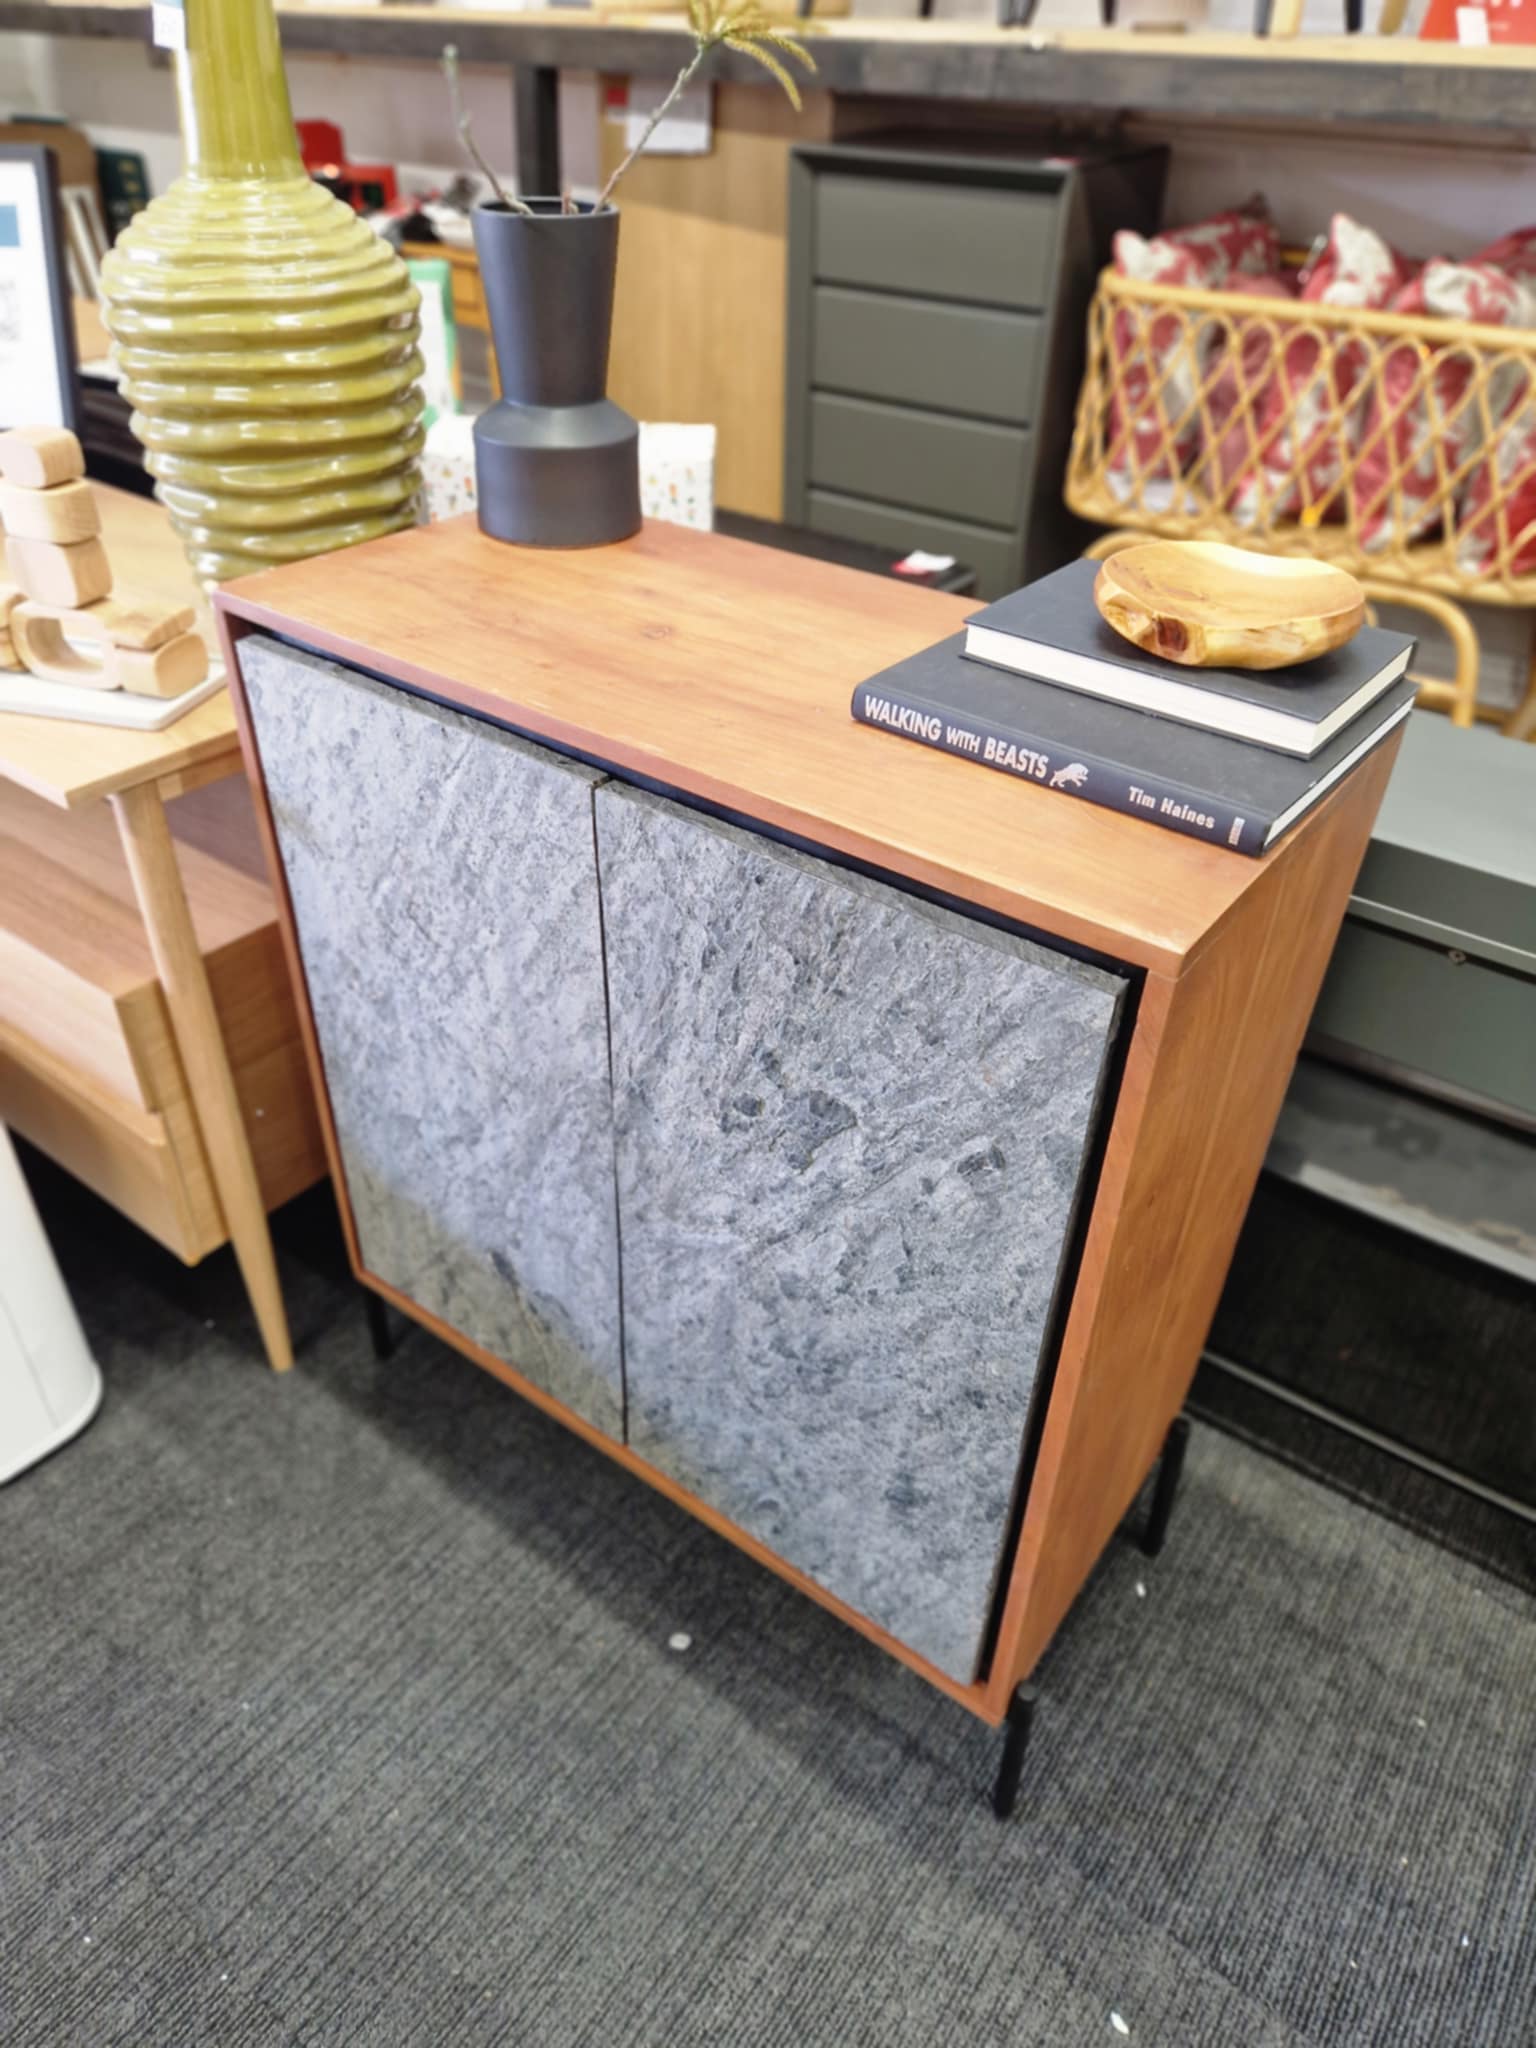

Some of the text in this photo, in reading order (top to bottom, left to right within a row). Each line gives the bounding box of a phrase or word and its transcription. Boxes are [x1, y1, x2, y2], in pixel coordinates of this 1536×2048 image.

[865, 695, 1049, 778] WALKING WITH BEASTS
[1128, 786, 1216, 829] Tim Haines
